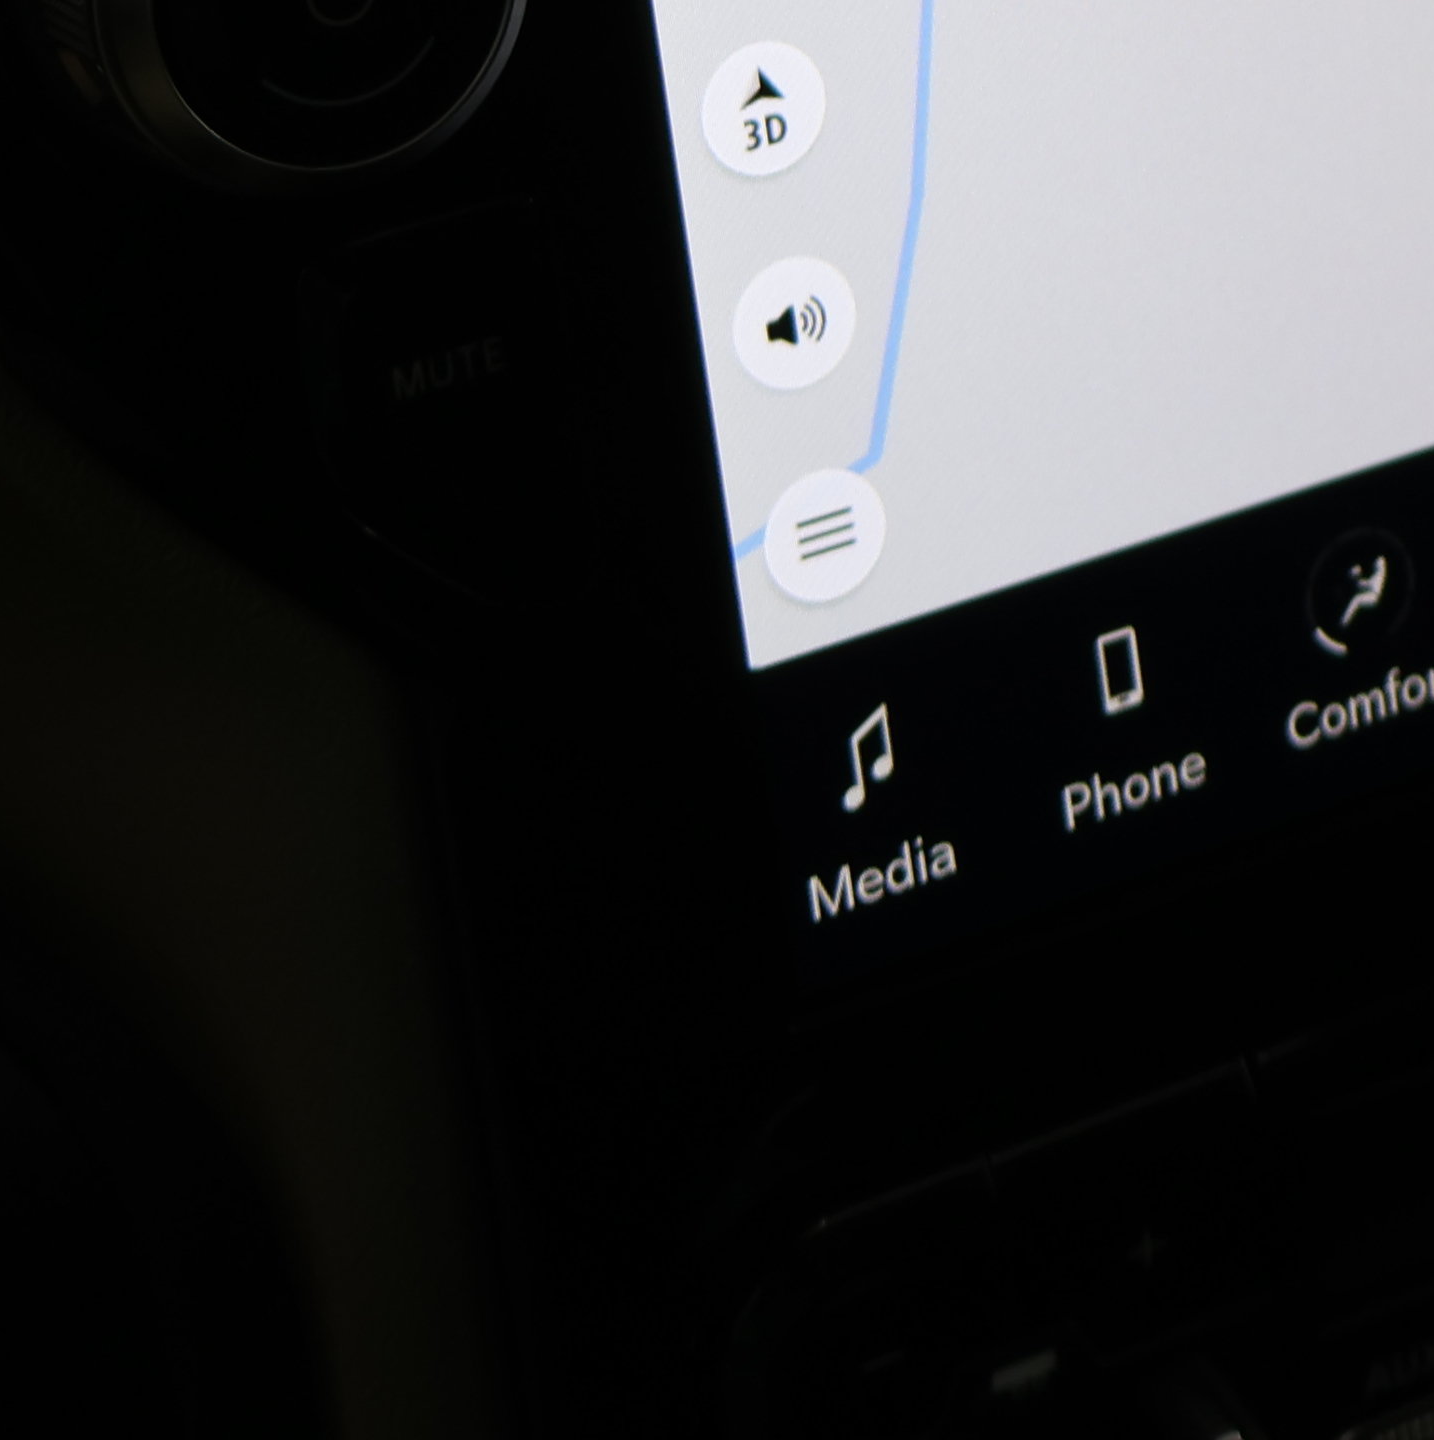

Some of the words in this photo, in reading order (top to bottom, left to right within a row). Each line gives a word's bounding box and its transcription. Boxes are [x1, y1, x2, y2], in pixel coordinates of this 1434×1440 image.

[743, 113, 789, 152] 3D
[389, 336, 504, 401] MUTE
[1061, 751, 1208, 834] Phone
[807, 834, 958, 924] Media
